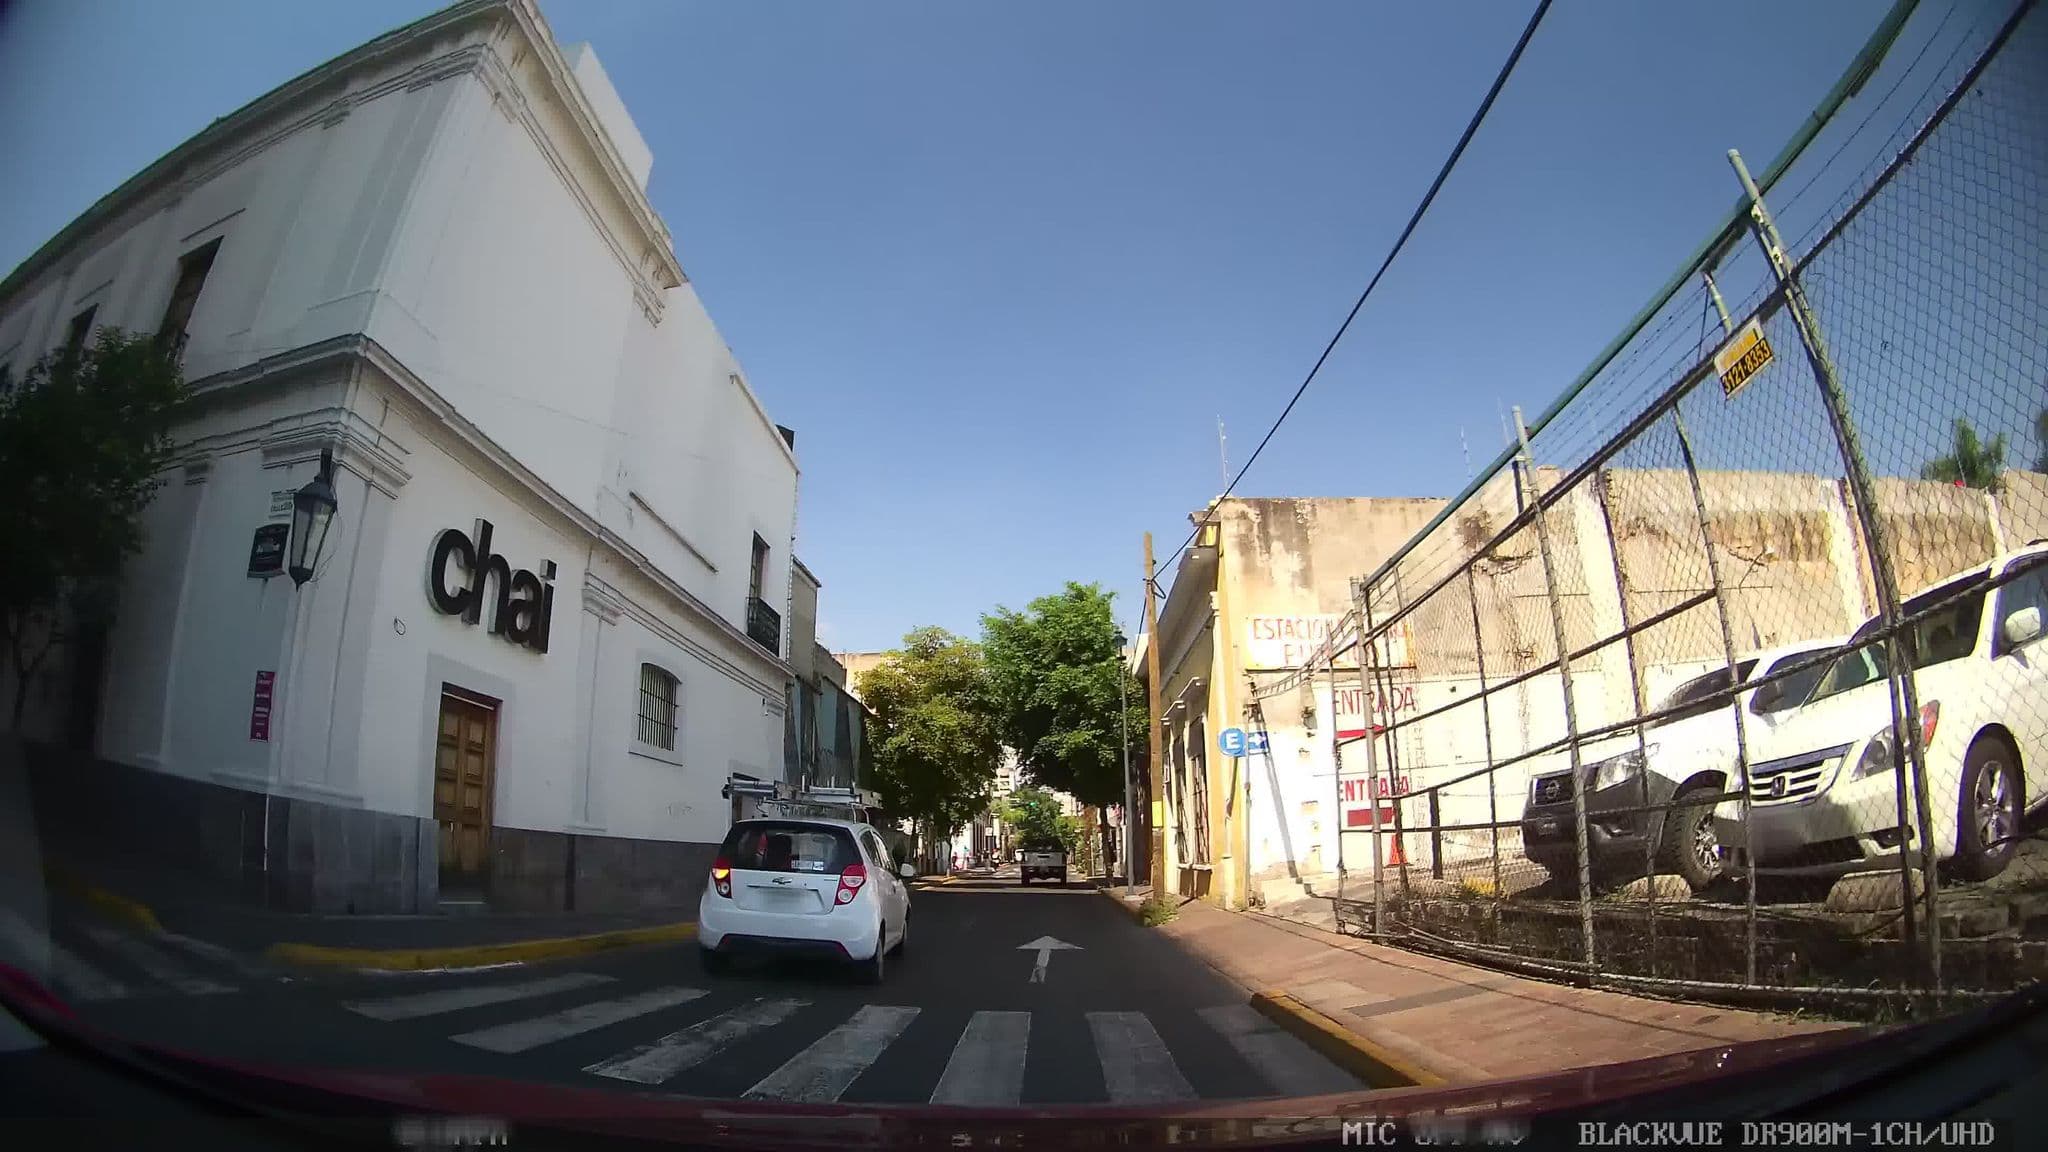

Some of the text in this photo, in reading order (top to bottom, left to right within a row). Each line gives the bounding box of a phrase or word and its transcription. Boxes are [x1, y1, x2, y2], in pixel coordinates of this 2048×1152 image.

[426, 518, 557, 655] chai
[1226, 733, 1240, 749] E
[1338, 776, 1410, 802] ENTAA
